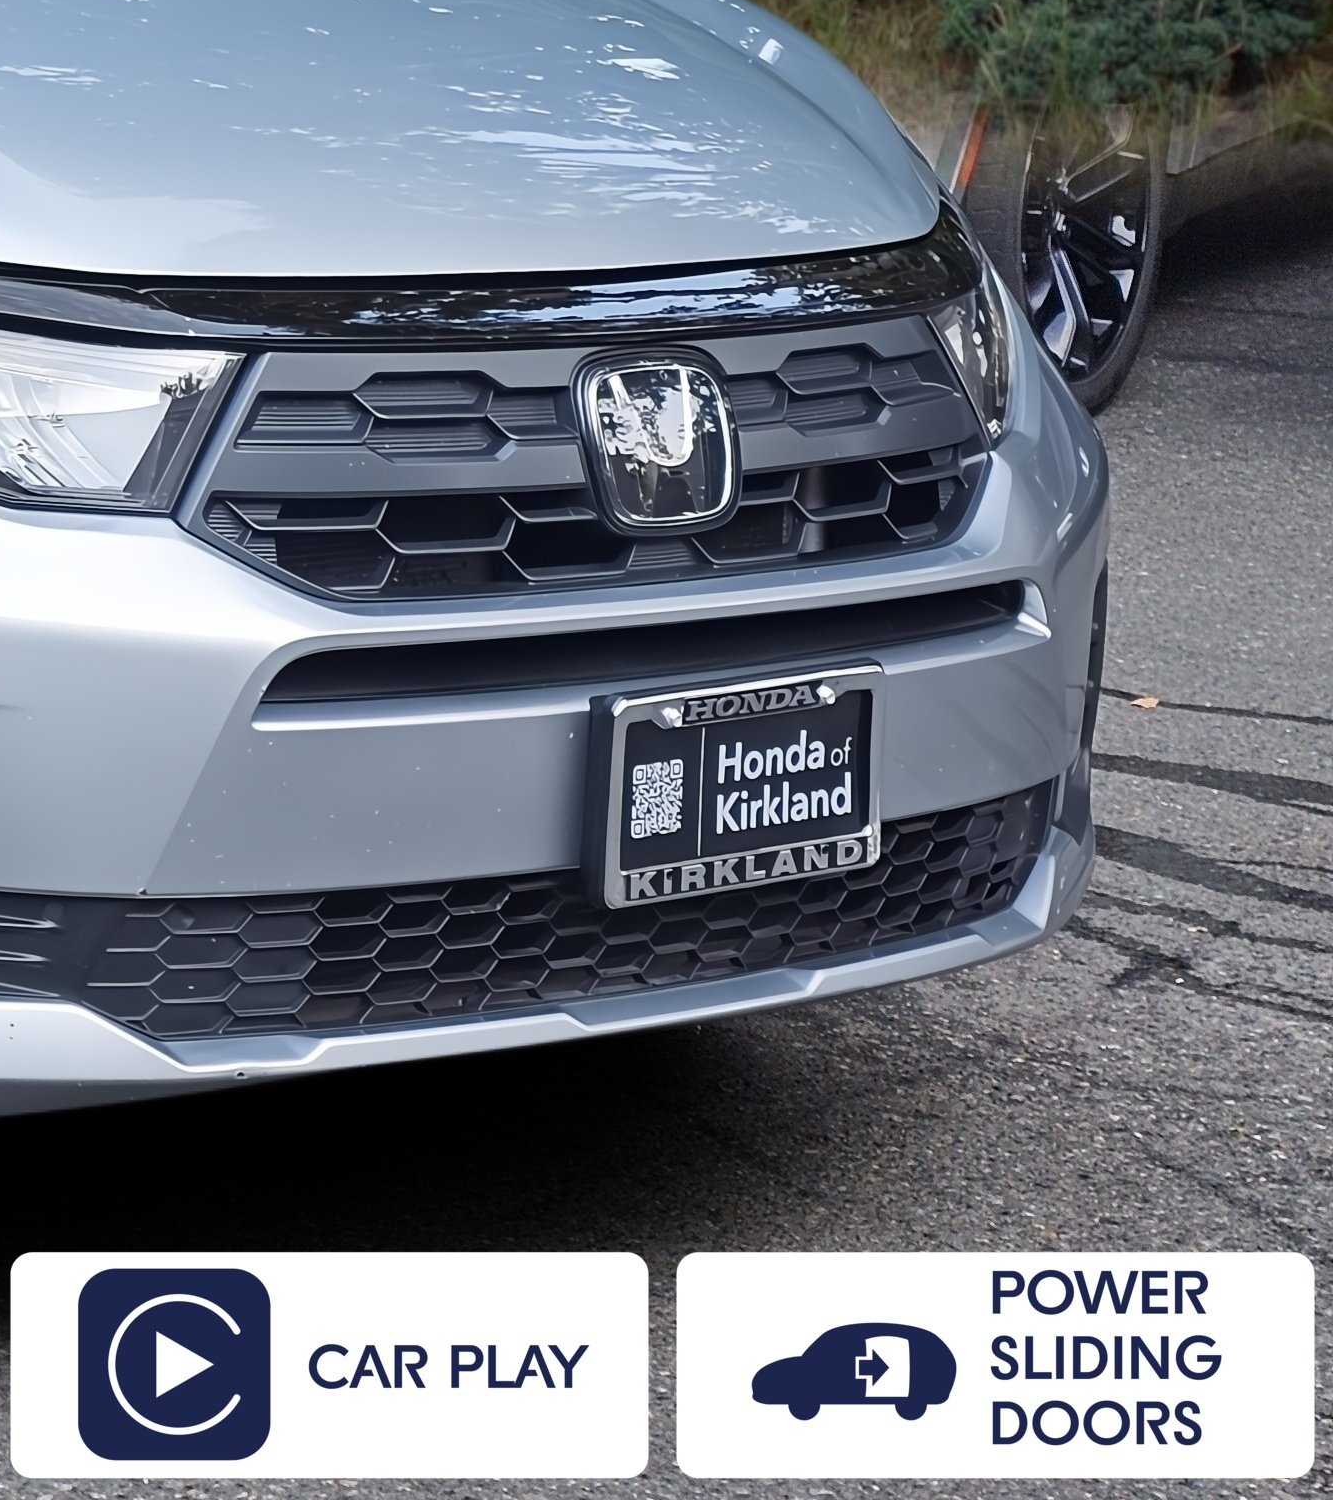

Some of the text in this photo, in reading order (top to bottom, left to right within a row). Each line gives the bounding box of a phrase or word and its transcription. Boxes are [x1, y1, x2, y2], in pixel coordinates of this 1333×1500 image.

[685, 684, 816, 722] HONDA
[717, 729, 853, 784] Honda of
[715, 771, 853, 835] Kirkland
[629, 840, 864, 900] KIRKLAND
